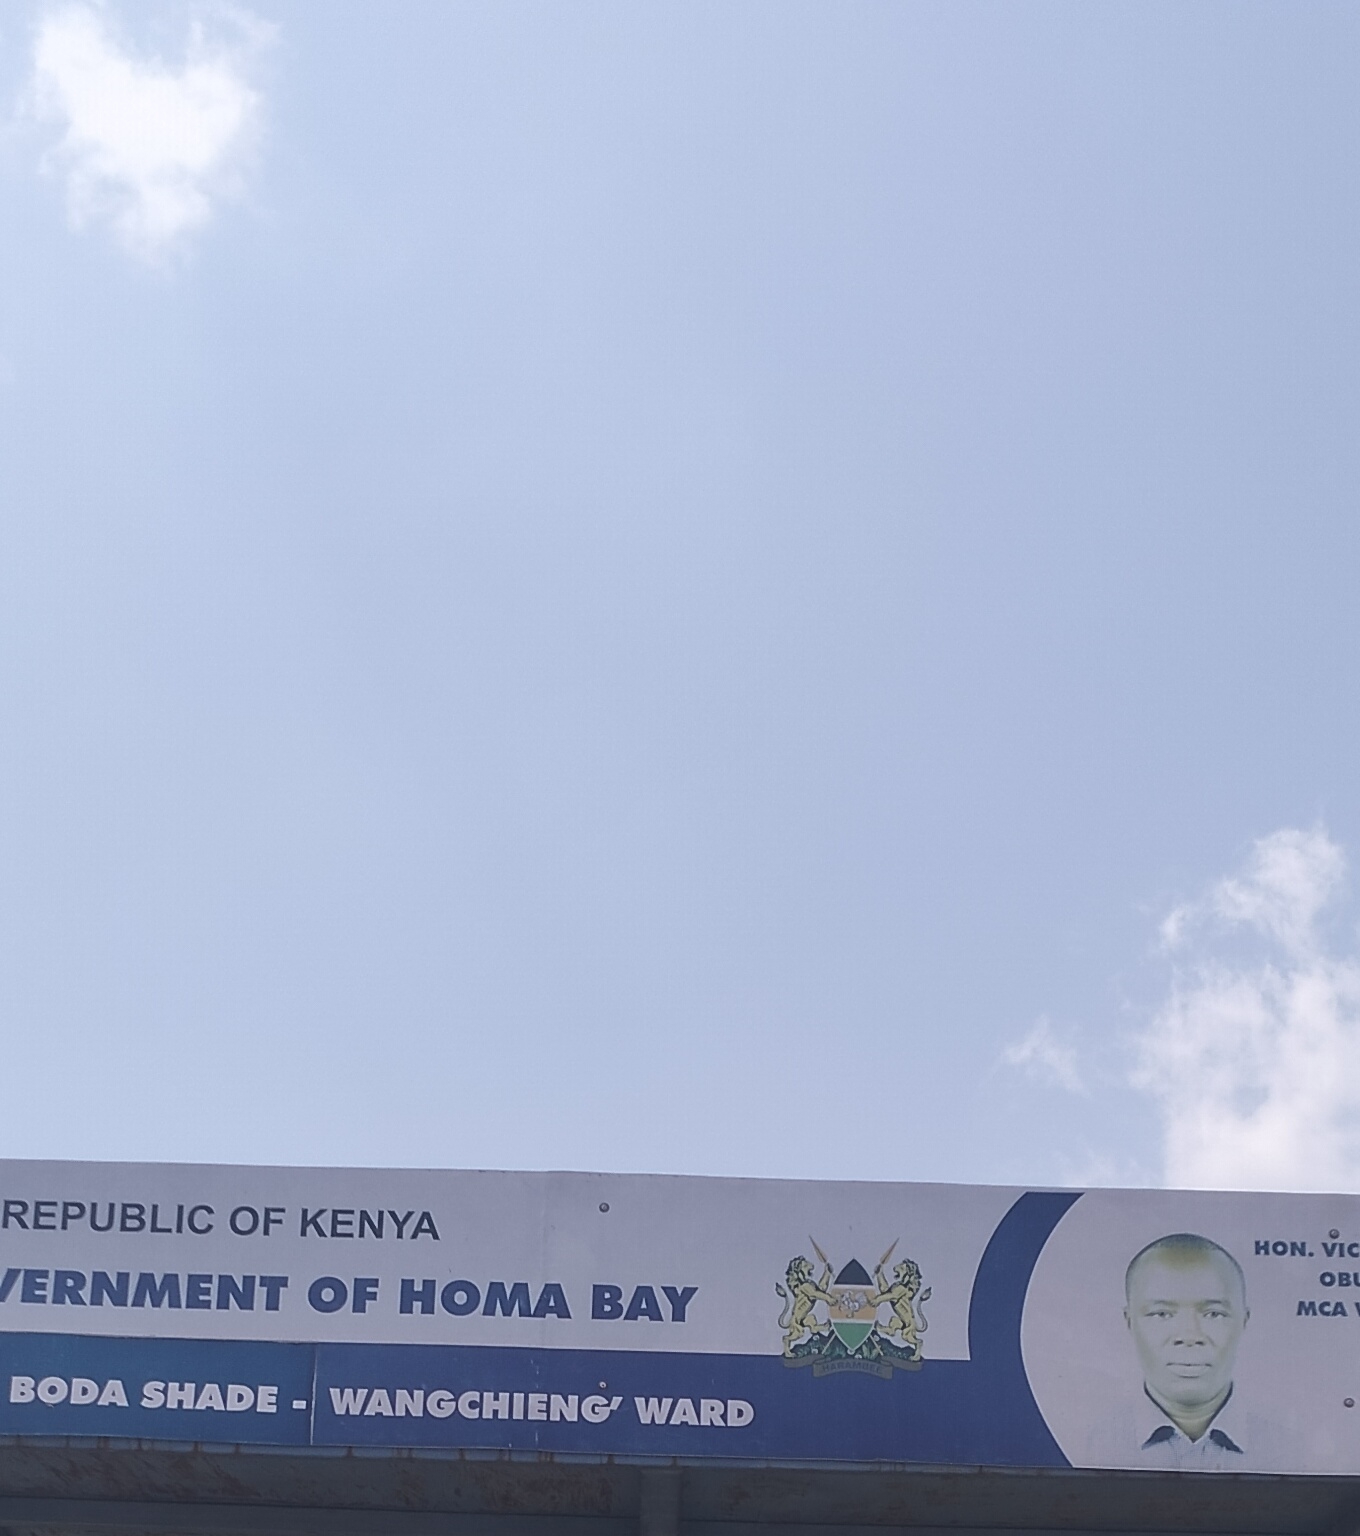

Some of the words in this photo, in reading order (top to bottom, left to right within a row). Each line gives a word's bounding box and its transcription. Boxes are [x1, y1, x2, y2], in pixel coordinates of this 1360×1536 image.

[2, 1200, 214, 1234] REPUBLIC
[230, 1206, 285, 1236] OF
[301, 1208, 439, 1240] KENYA
[1255, 1241, 1314, 1257] HON.
[308, 1277, 379, 1313] OF
[400, 1279, 571, 1319] HOMA
[592, 1284, 698, 1322] BAY
[1297, 1301, 1347, 1316] MCA
[10, 1376, 128, 1406] BODA
[141, 1381, 278, 1412] SHADE
[329, 1388, 623, 1422] WANGCHIENG'
[634, 1397, 754, 1426] WARD
